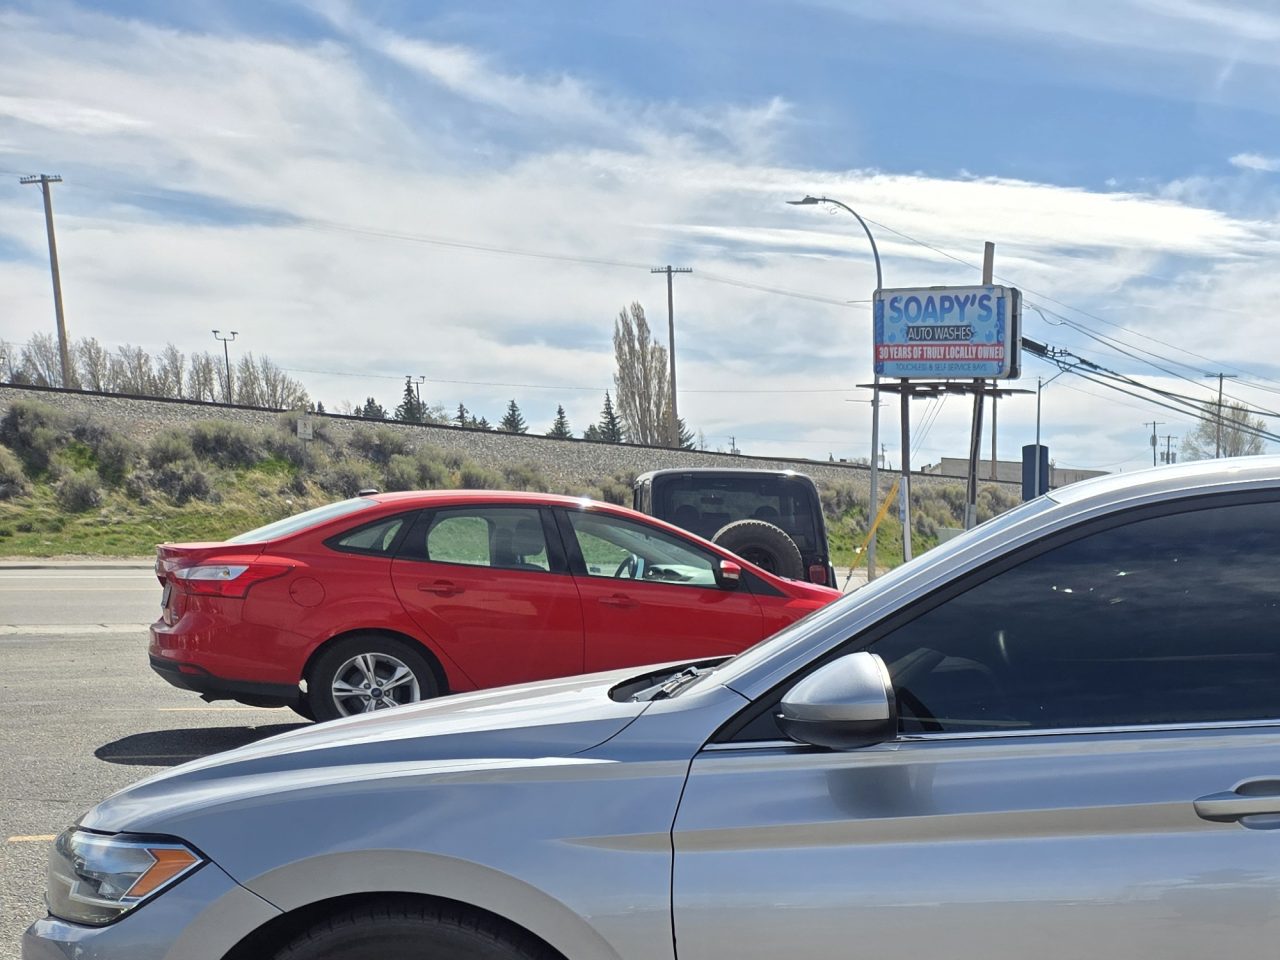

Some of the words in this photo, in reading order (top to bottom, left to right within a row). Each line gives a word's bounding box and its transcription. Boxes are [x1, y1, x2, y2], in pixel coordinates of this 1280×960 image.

[889, 293, 993, 324] SOAPY'S
[908, 327, 933, 340] AUTO
[934, 326, 972, 340] WASHES
[879, 346, 889, 359] 30
[890, 346, 912, 359] YEARS
[913, 346, 922, 358] OF
[923, 346, 945, 359] TRULY
[945, 346, 977, 359] LOCALLY
[977, 346, 1004, 359] OWNED
